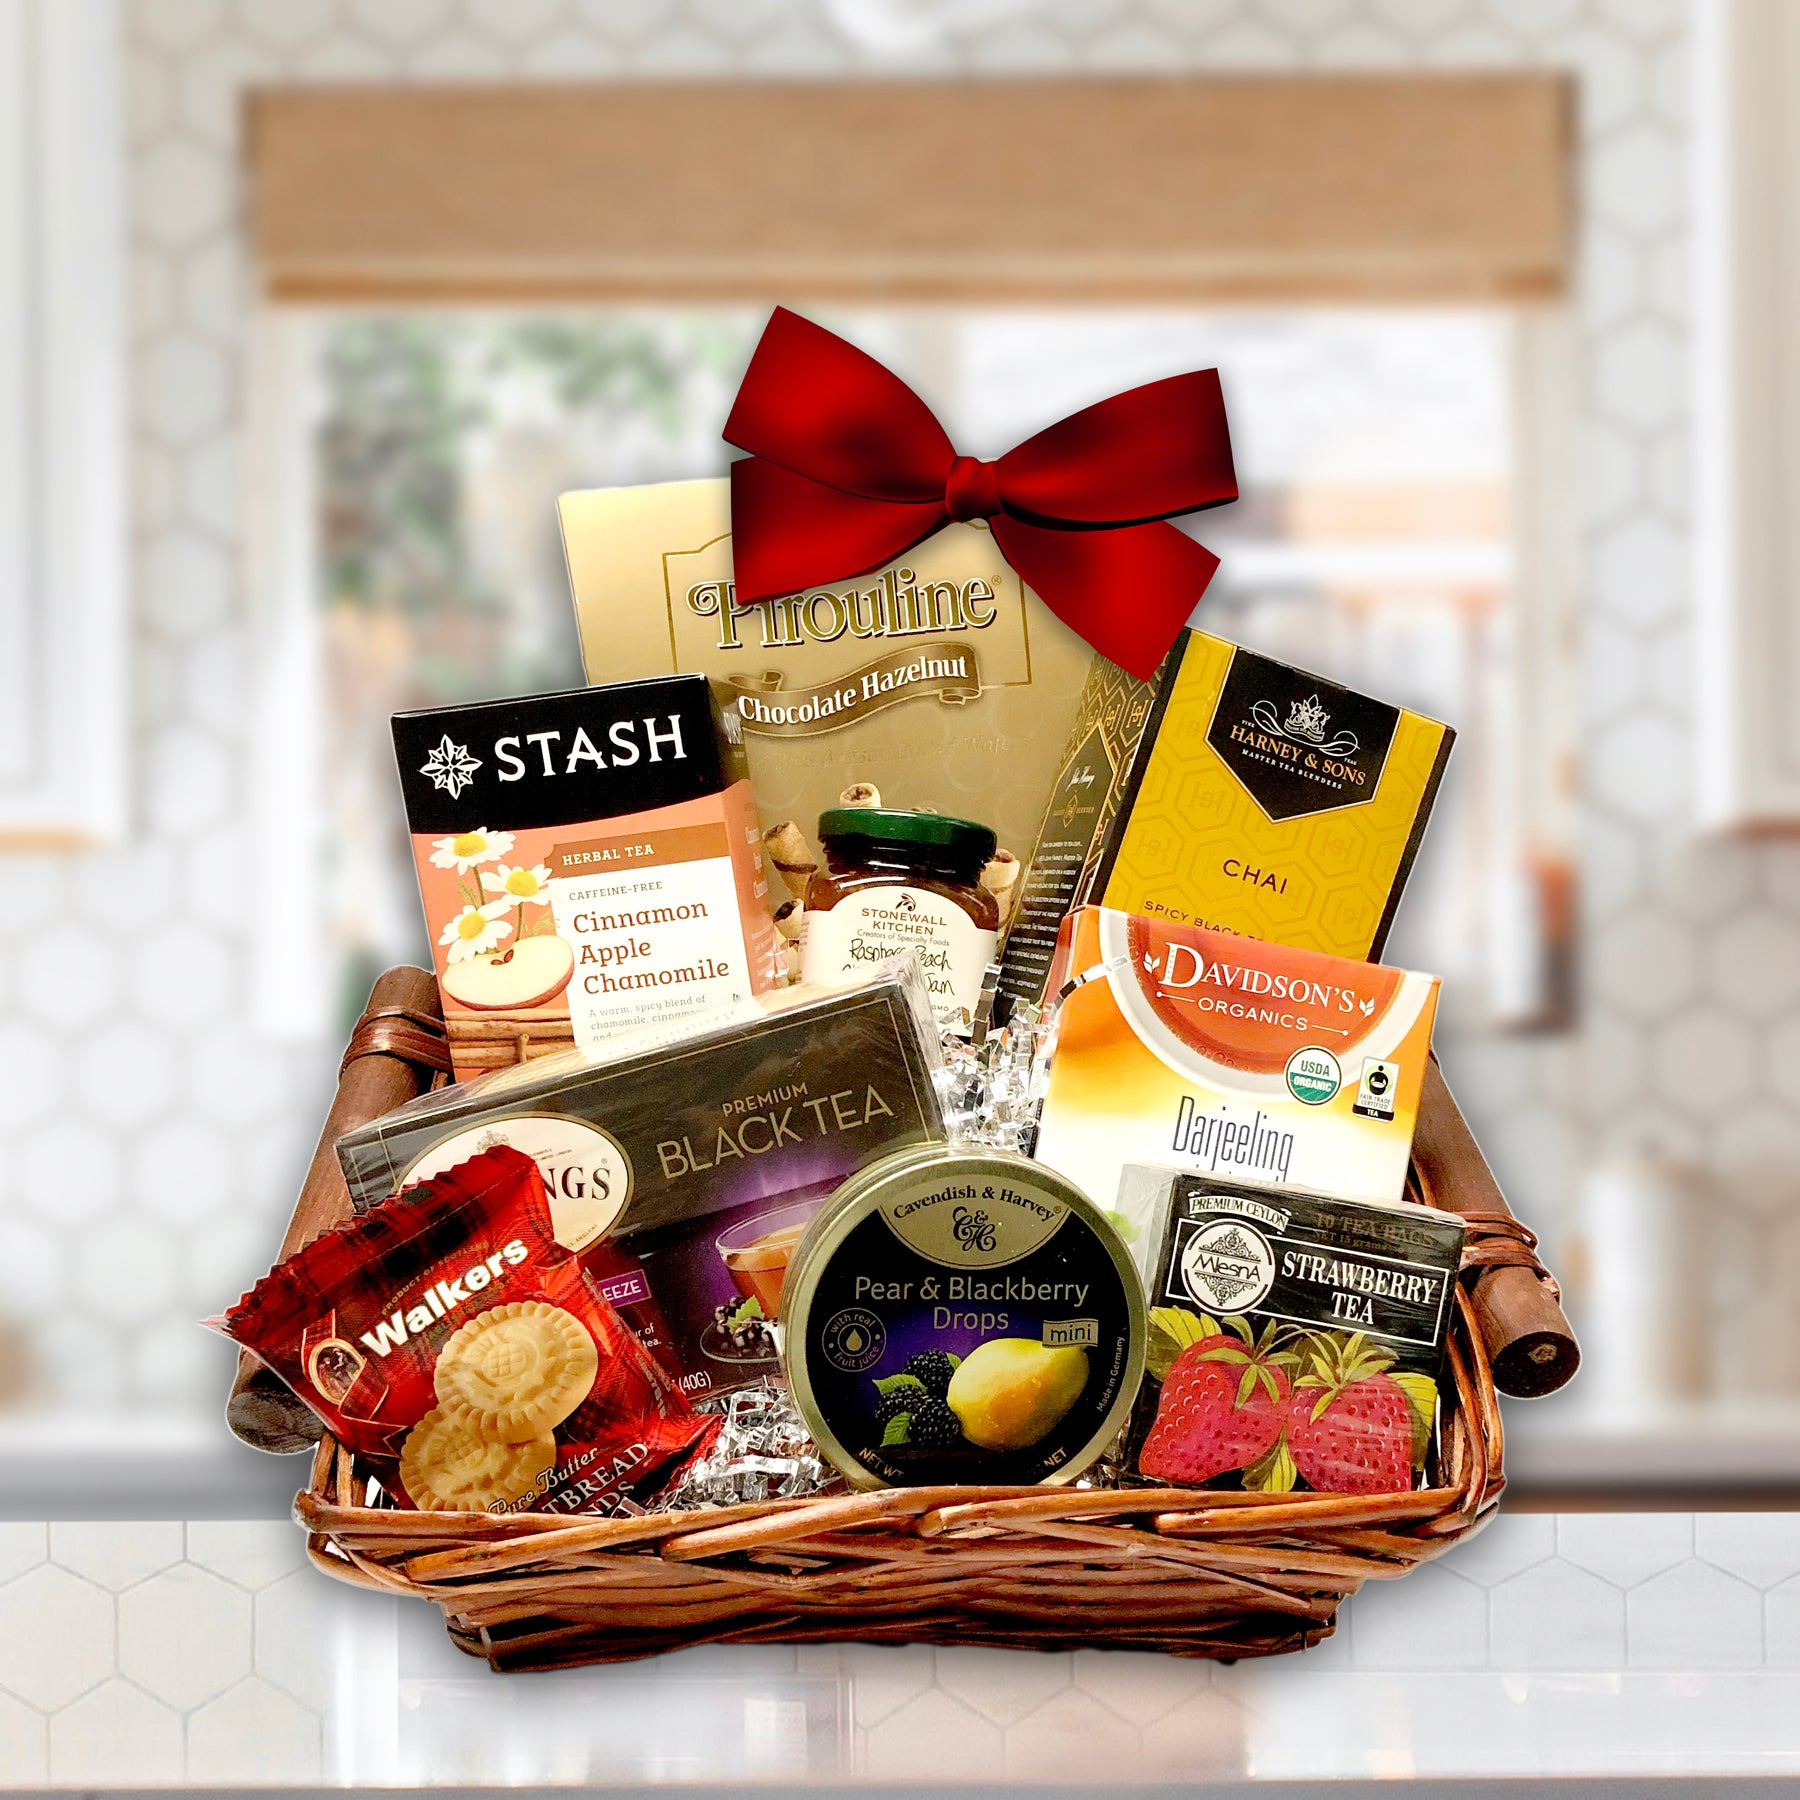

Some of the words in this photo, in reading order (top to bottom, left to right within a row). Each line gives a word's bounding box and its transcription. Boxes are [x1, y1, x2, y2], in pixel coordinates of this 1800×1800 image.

[738, 688, 857, 725] Chocolate
[861, 656, 968, 701] Hazelnut
[494, 714, 687, 782] STASH
[1230, 725, 1302, 762] HARNEY
[1304, 753, 1317, 769] &
[1322, 759, 1366, 786] SONS
[1242, 749, 1276, 766] MASTER
[1279, 762, 1295, 773] TEA
[1298, 769, 1342, 789] BLENDERS
[562, 847, 621, 866] HERBAL
[624, 844, 654, 858] TEA
[569, 881, 663, 901] CAFFEINE-FREE
[1222, 859, 1288, 894] CHAI
[573, 902, 708, 933] Cinnamon
[861, 907, 947, 926] STONEWALL
[1144, 900, 1189, 921] SPICY
[857, 928, 886, 939] Creators
[888, 932, 896, 940] of
[898, 933, 928, 945] Specialty
[929, 938, 949, 946] Foods
[873, 920, 934, 935] KITCHEN
[579, 938, 651, 969] Apple
[915, 945, 953, 971] Peach
[584, 959, 729, 995] Chamomile
[925, 972, 955, 996] Jam
[1158, 942, 1355, 1013] DAVIDSON'S
[589, 1009, 597, 1018] A
[600, 1005, 632, 1016] warm,
[635, 1002, 662, 1014] spicy
[664, 996, 692, 1008] blend
[695, 994, 706, 1003] of
[1198, 997, 1308, 1031] ORGANICS
[1293, 1075, 1332, 1092] ORGANIC
[1300, 1060, 1330, 1077] USDA
[722, 1082, 808, 1117] PREMIUM
[1367, 1109, 1378, 1117] TEA
[1374, 1096, 1390, 1105] TRADE
[657, 1106, 803, 1179] BLACK
[803, 1084, 895, 1136] TEA
[1173, 1095, 1294, 1182] Darjeeling
[893, 1185, 976, 1219] Cavendish
[982, 1186, 995, 1200] &
[1000, 1188, 1054, 1222] Harvey
[1191, 1197, 1243, 1213] PREMIUM
[1246, 1202, 1288, 1231] CEYLON
[856, 1276, 913, 1300] Pear
[919, 1276, 941, 1300] &
[949, 1276, 1090, 1307] Blackberry
[1281, 1250, 1438, 1304] STRAWBERRY
[360, 1239, 528, 1357] Walkers
[381, 1275, 421, 1316] PRODUCT
[1331, 1291, 1374, 1325] TEA
[645, 1322, 655, 1335] of
[830, 1313, 852, 1333] with
[854, 1313, 876, 1327] real
[933, 1306, 1009, 1336] Drops
[1049, 1322, 1092, 1343] mini
[834, 1351, 856, 1368] fruit
[858, 1345, 880, 1368] juice
[1110, 1336, 1126, 1377] Germany
[678, 1370, 712, 1396] (40G)
[1106, 1377, 1117, 1388] in
[1096, 1388, 1113, 1412] Made
[859, 1447, 885, 1469] NET
[1043, 1446, 1067, 1467] NET
[487, 1489, 536, 1514] Pure
[535, 1447, 598, 1494] Butter
